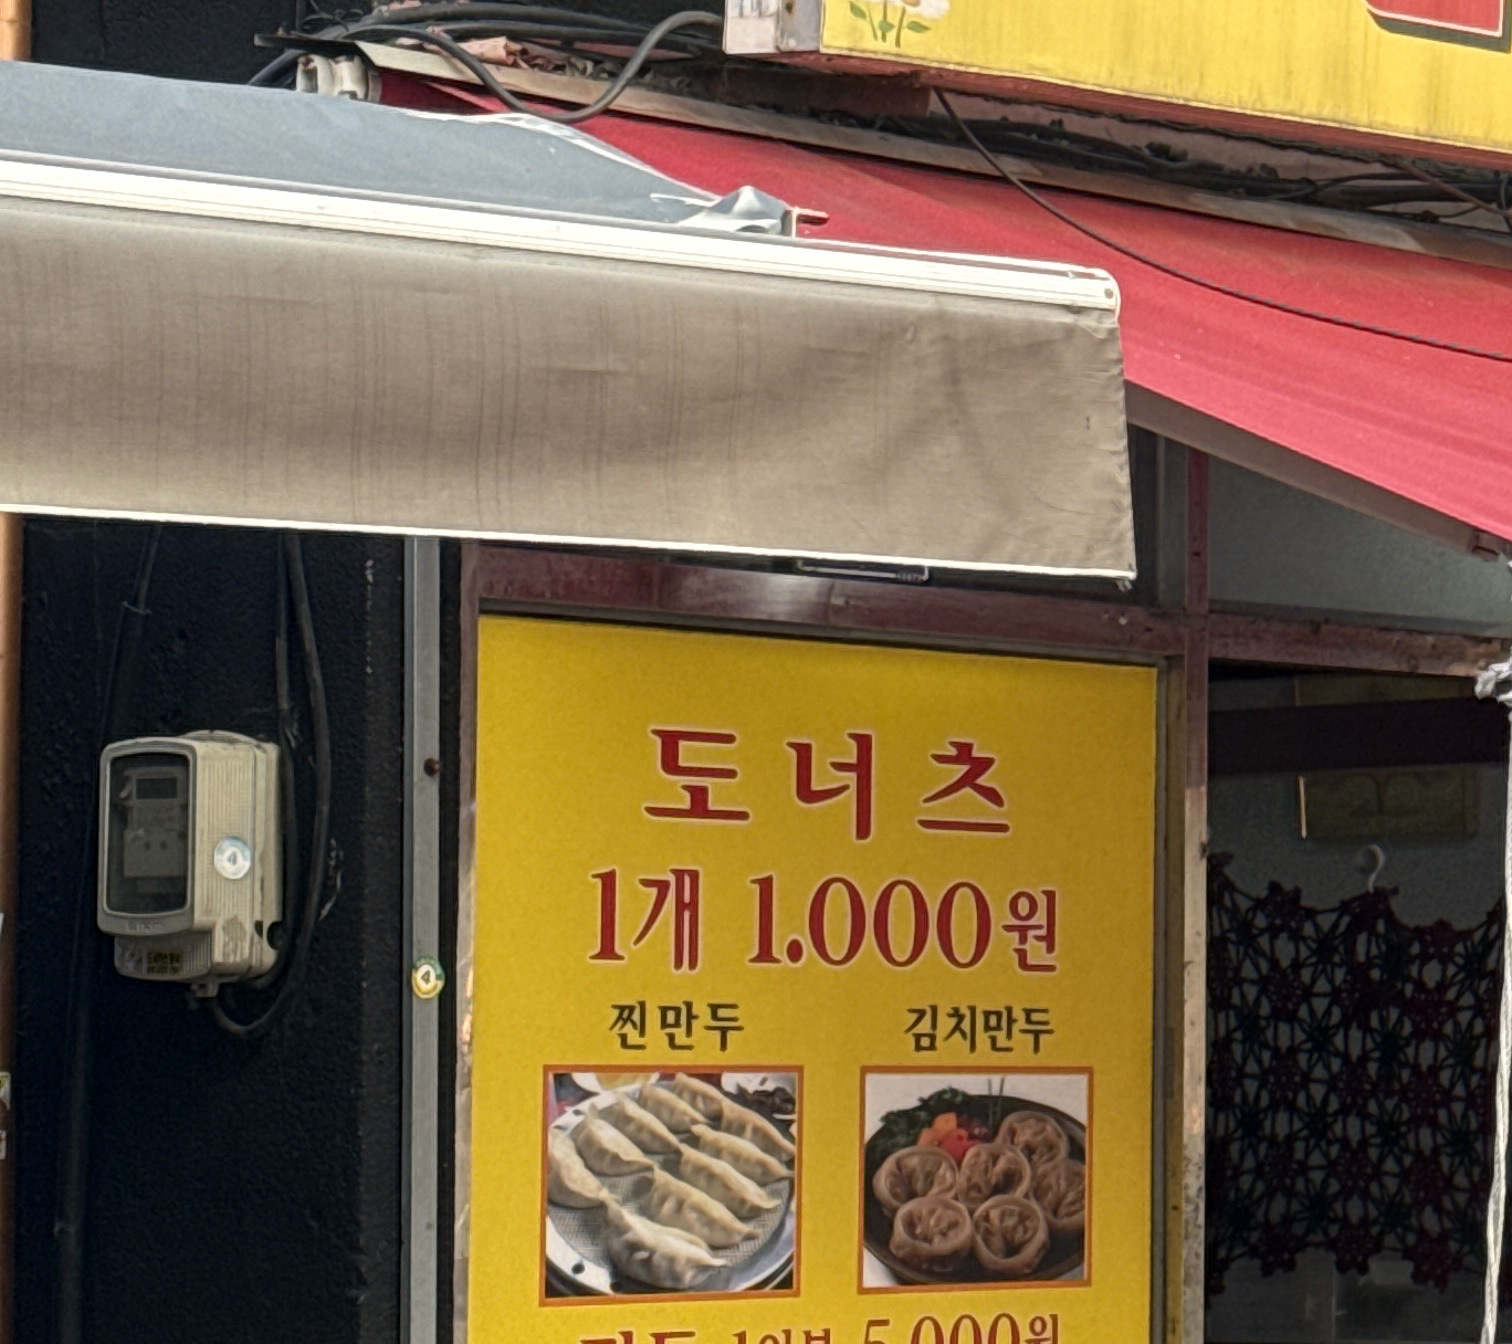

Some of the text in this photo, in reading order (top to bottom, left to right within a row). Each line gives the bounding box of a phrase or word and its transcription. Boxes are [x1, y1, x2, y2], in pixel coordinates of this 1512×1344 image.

[643, 727, 1011, 841] 도너츠
[589, 867, 1060, 974] 1개 1.000원
[607, 1000, 746, 1052] 찐만두
[903, 1003, 1057, 1055] 김치만두
